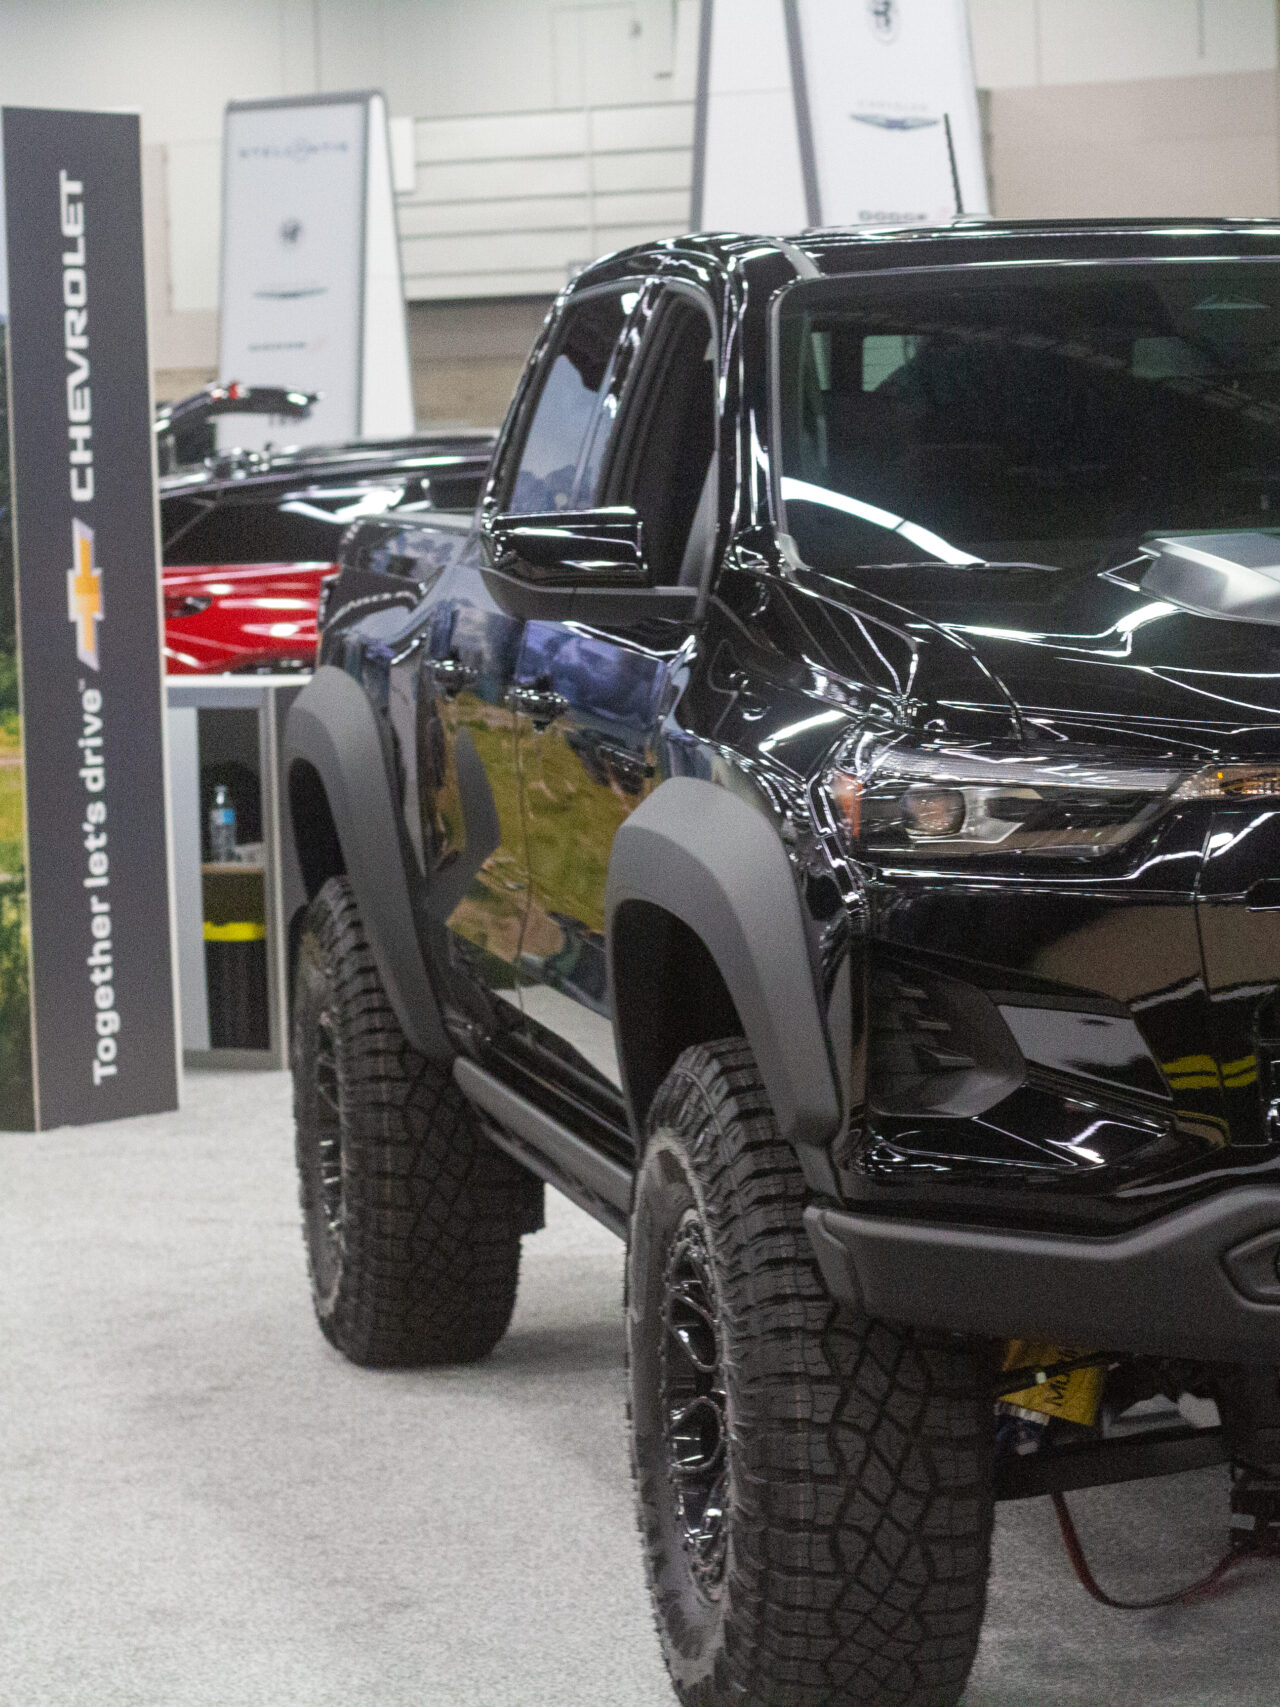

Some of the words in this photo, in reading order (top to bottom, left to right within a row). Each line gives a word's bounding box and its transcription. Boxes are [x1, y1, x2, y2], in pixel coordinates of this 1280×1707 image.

[59, 169, 94, 502] CHEVROLET
[78, 687, 106, 792] drive
[82, 800, 110, 888] let's
[87, 895, 121, 1086] Together
